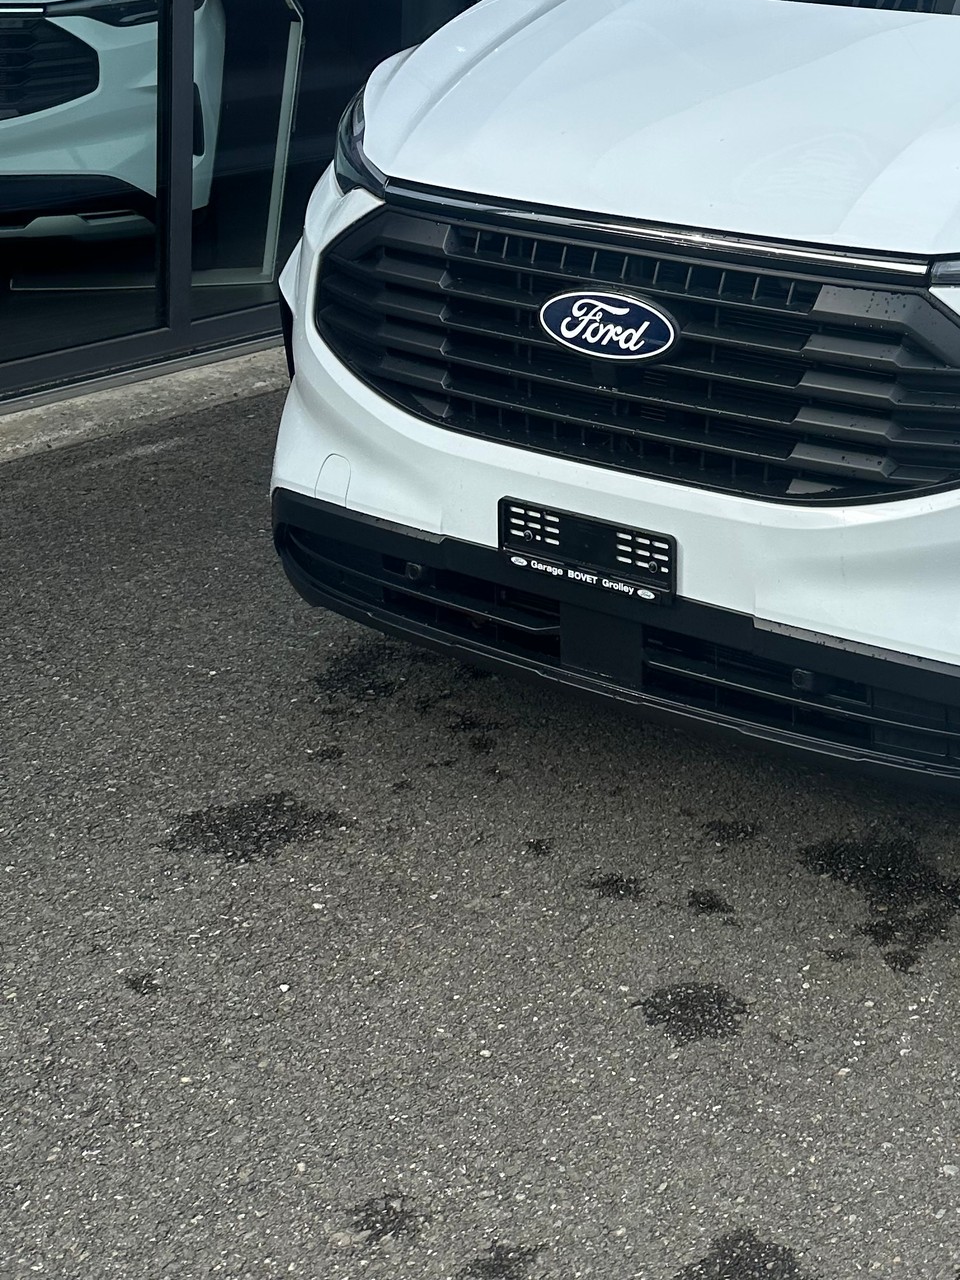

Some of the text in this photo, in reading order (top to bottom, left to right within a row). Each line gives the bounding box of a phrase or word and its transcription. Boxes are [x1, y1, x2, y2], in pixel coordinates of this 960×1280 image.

[560, 298, 651, 351] Ford
[530, 560, 564, 576] Garage
[567, 569, 598, 584] BOVET
[602, 579, 635, 595] Grolley
